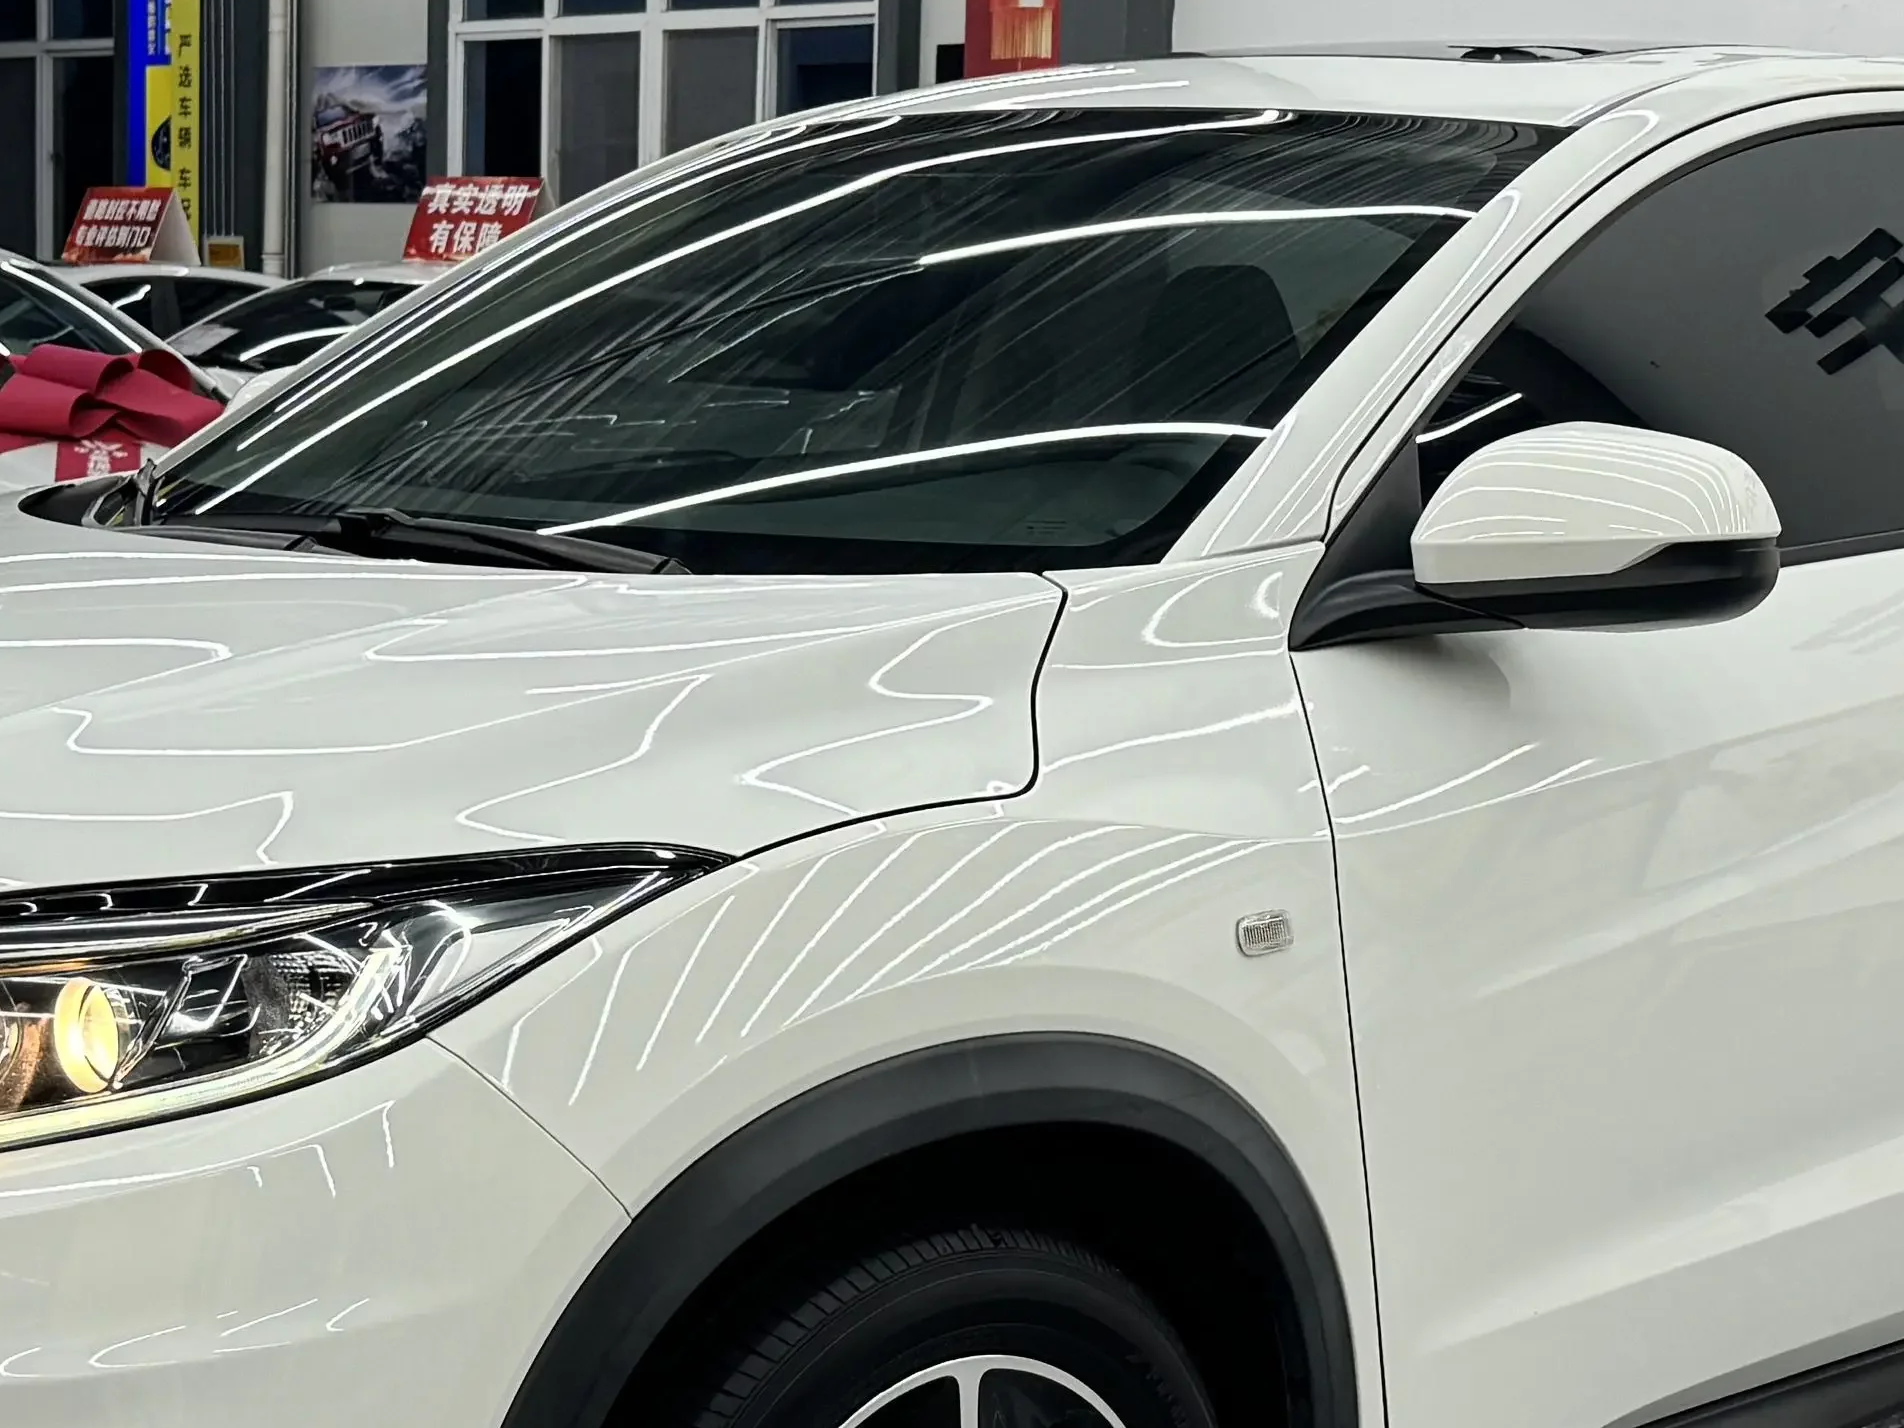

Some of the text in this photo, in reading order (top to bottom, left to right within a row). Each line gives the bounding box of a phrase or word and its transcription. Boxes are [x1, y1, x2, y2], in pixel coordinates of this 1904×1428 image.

[427, 182, 530, 216] 真实透明
[428, 219, 503, 254] 有保障
